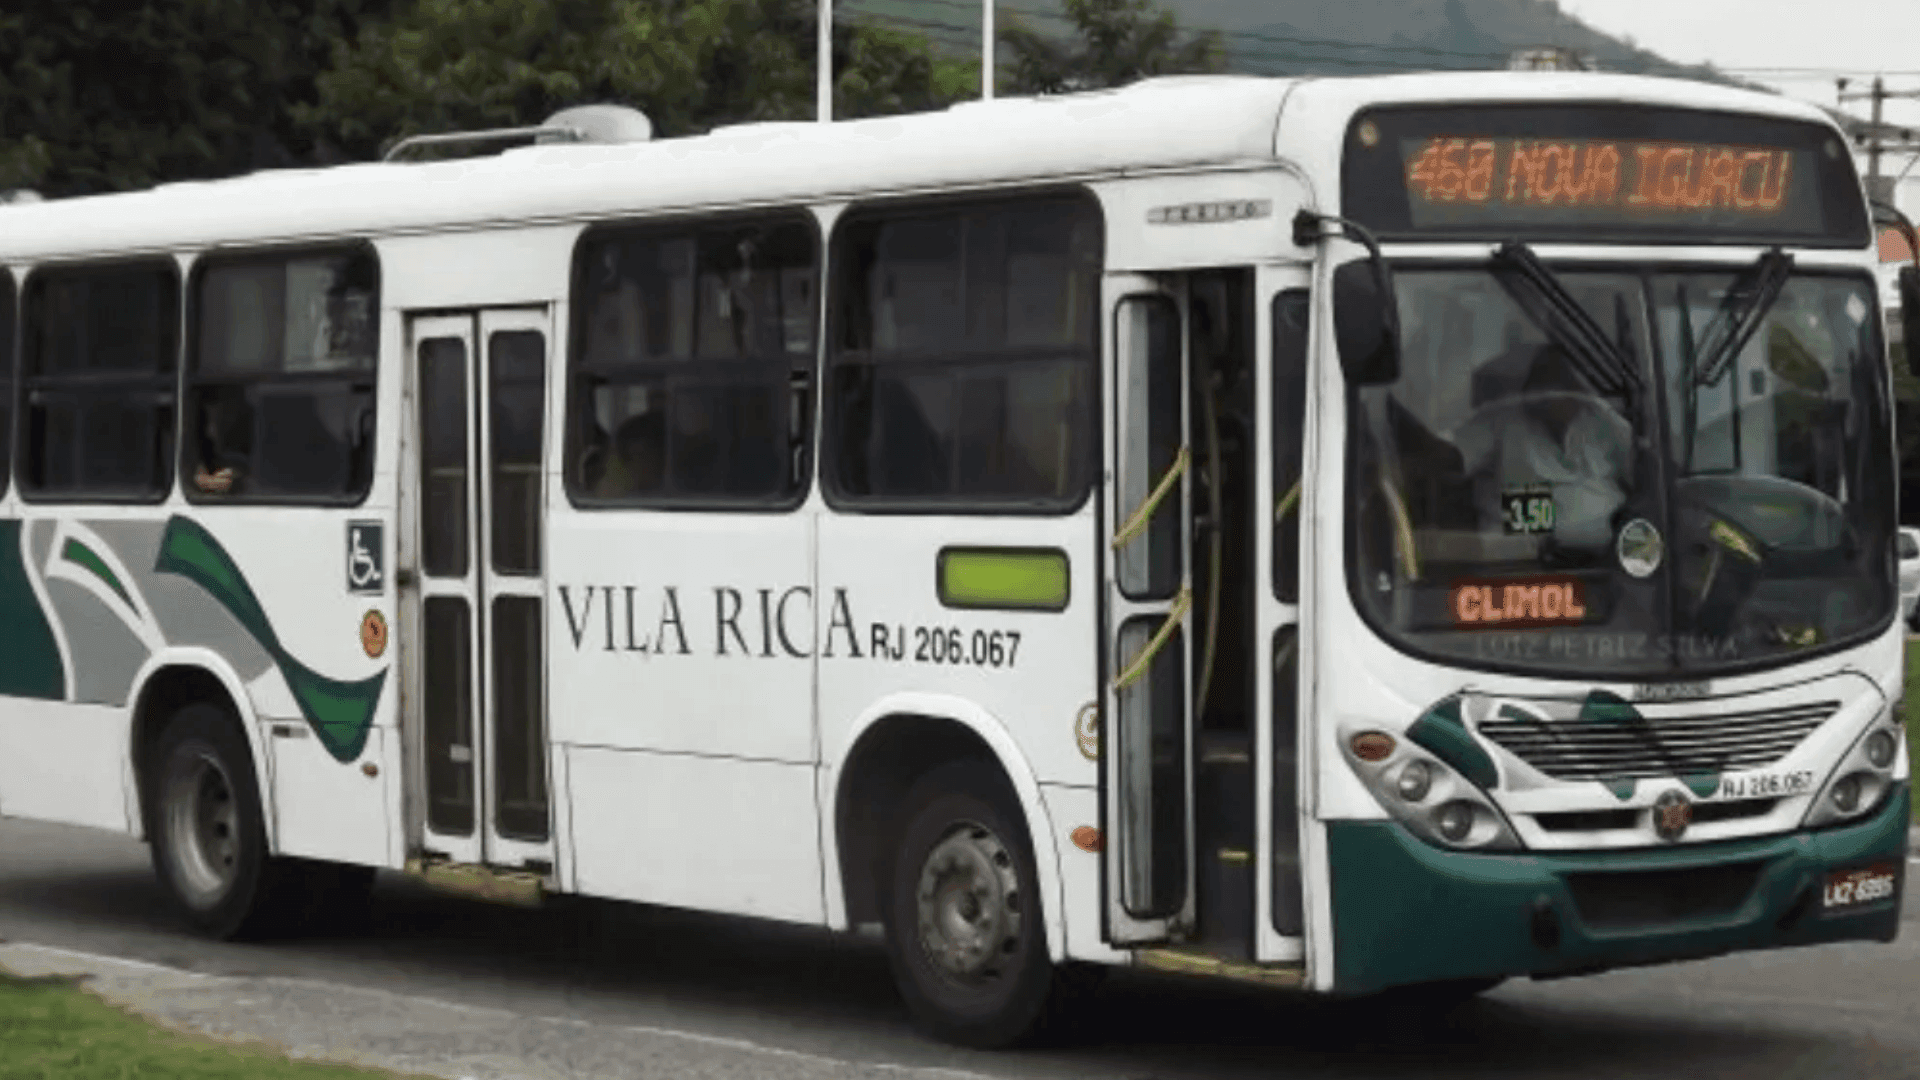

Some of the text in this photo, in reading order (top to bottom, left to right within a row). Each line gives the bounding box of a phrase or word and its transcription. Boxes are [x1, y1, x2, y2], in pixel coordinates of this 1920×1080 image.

[1410, 137, 1790, 208] 460 NOVA IGUACU
[557, 585, 864, 659] VILA RICA
[1456, 583, 1586, 622] CLIMOL
[870, 622, 1022, 668] RJ 206.067
